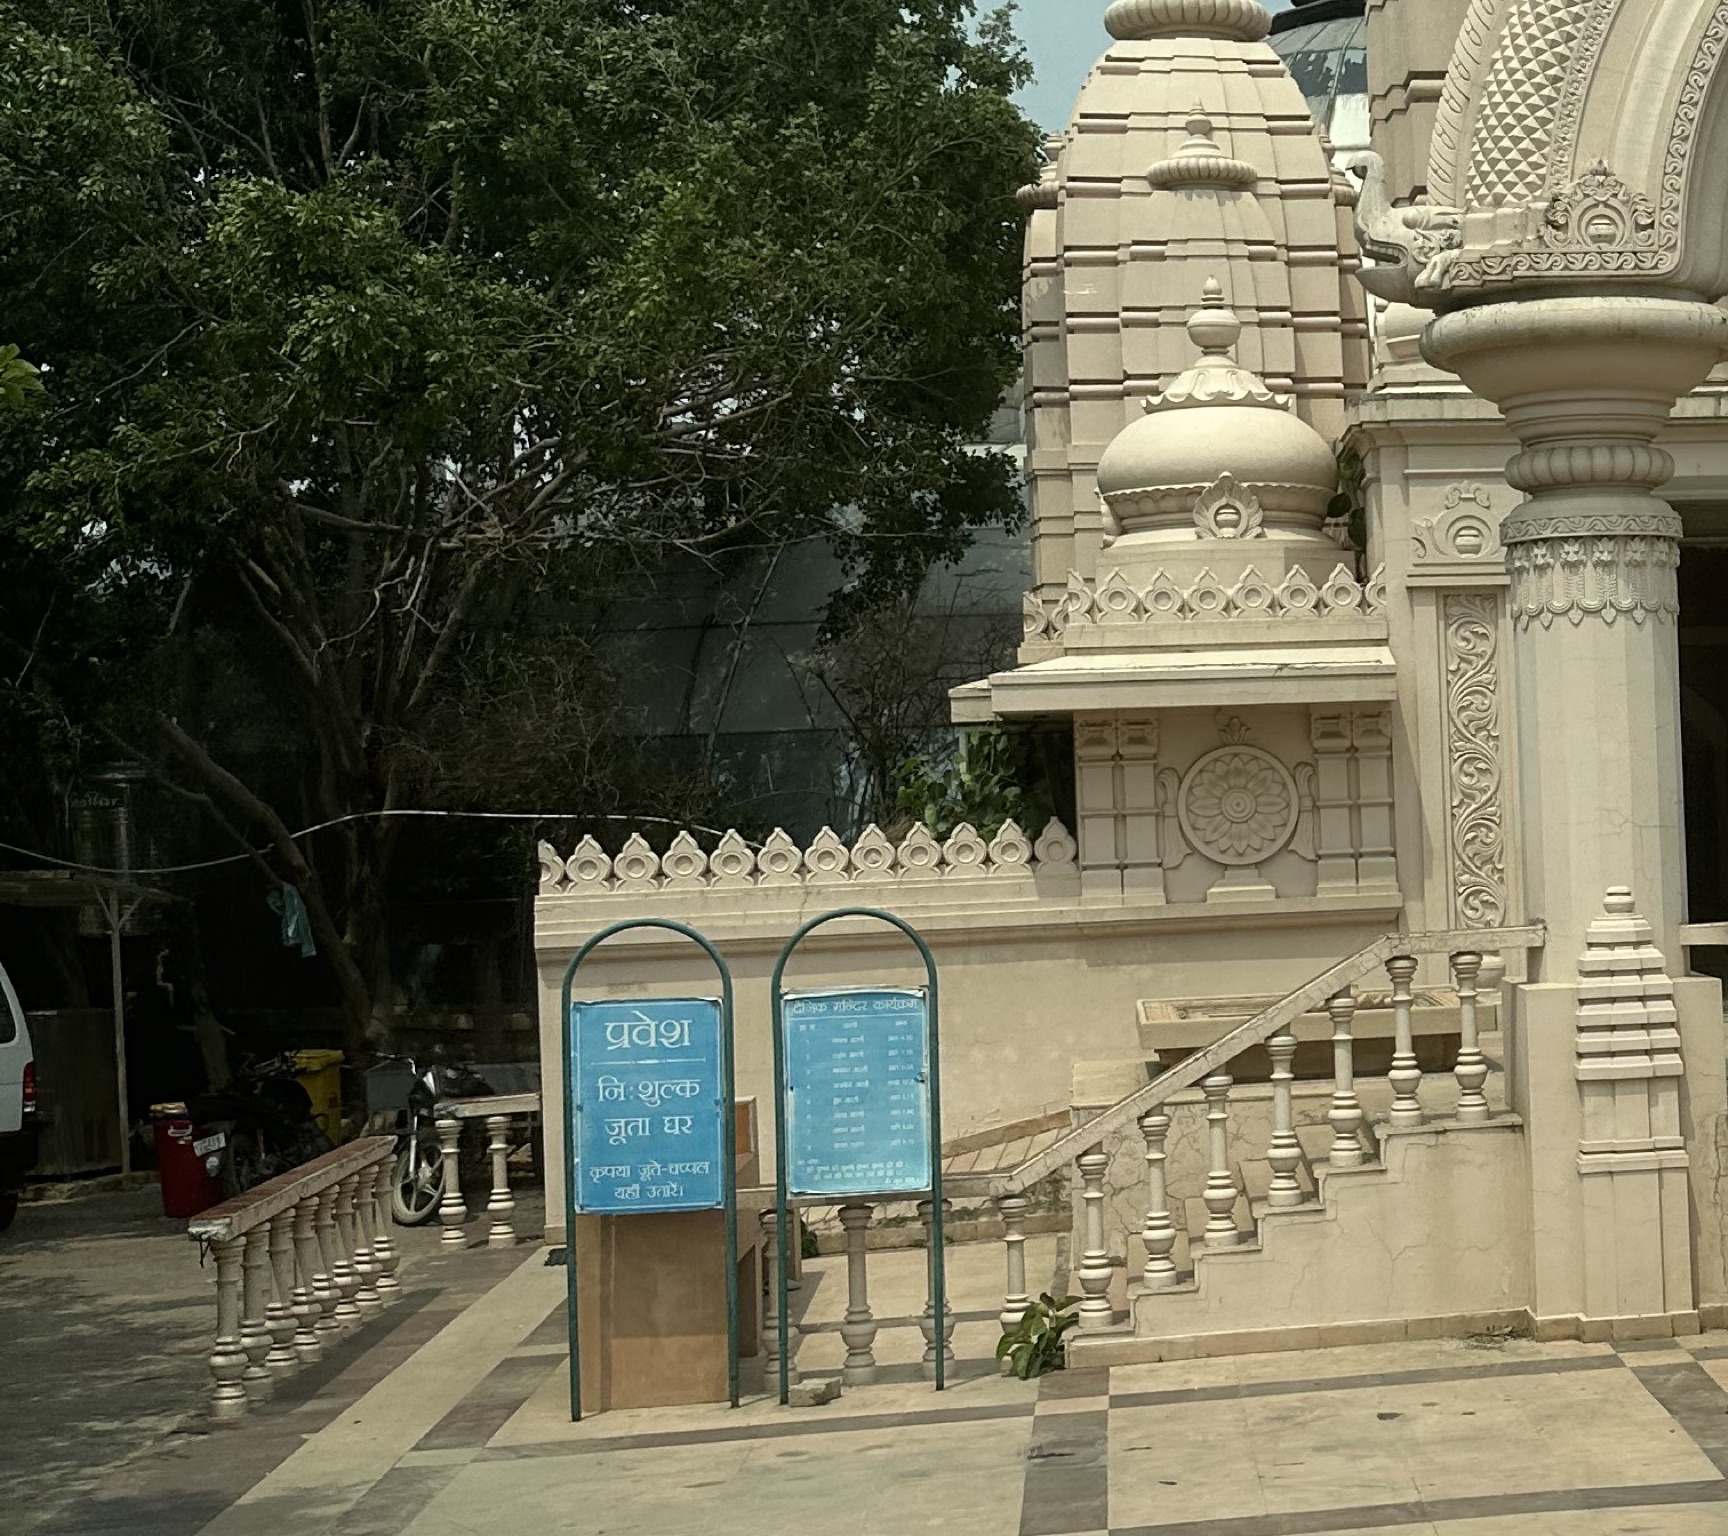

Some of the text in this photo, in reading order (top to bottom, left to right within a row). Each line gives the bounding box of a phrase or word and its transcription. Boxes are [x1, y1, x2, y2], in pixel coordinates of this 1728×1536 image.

[604, 1010, 693, 1051] प्रवेश
[604, 1115, 695, 1145] जूता घर
[589, 1165, 631, 1183] कृपया
